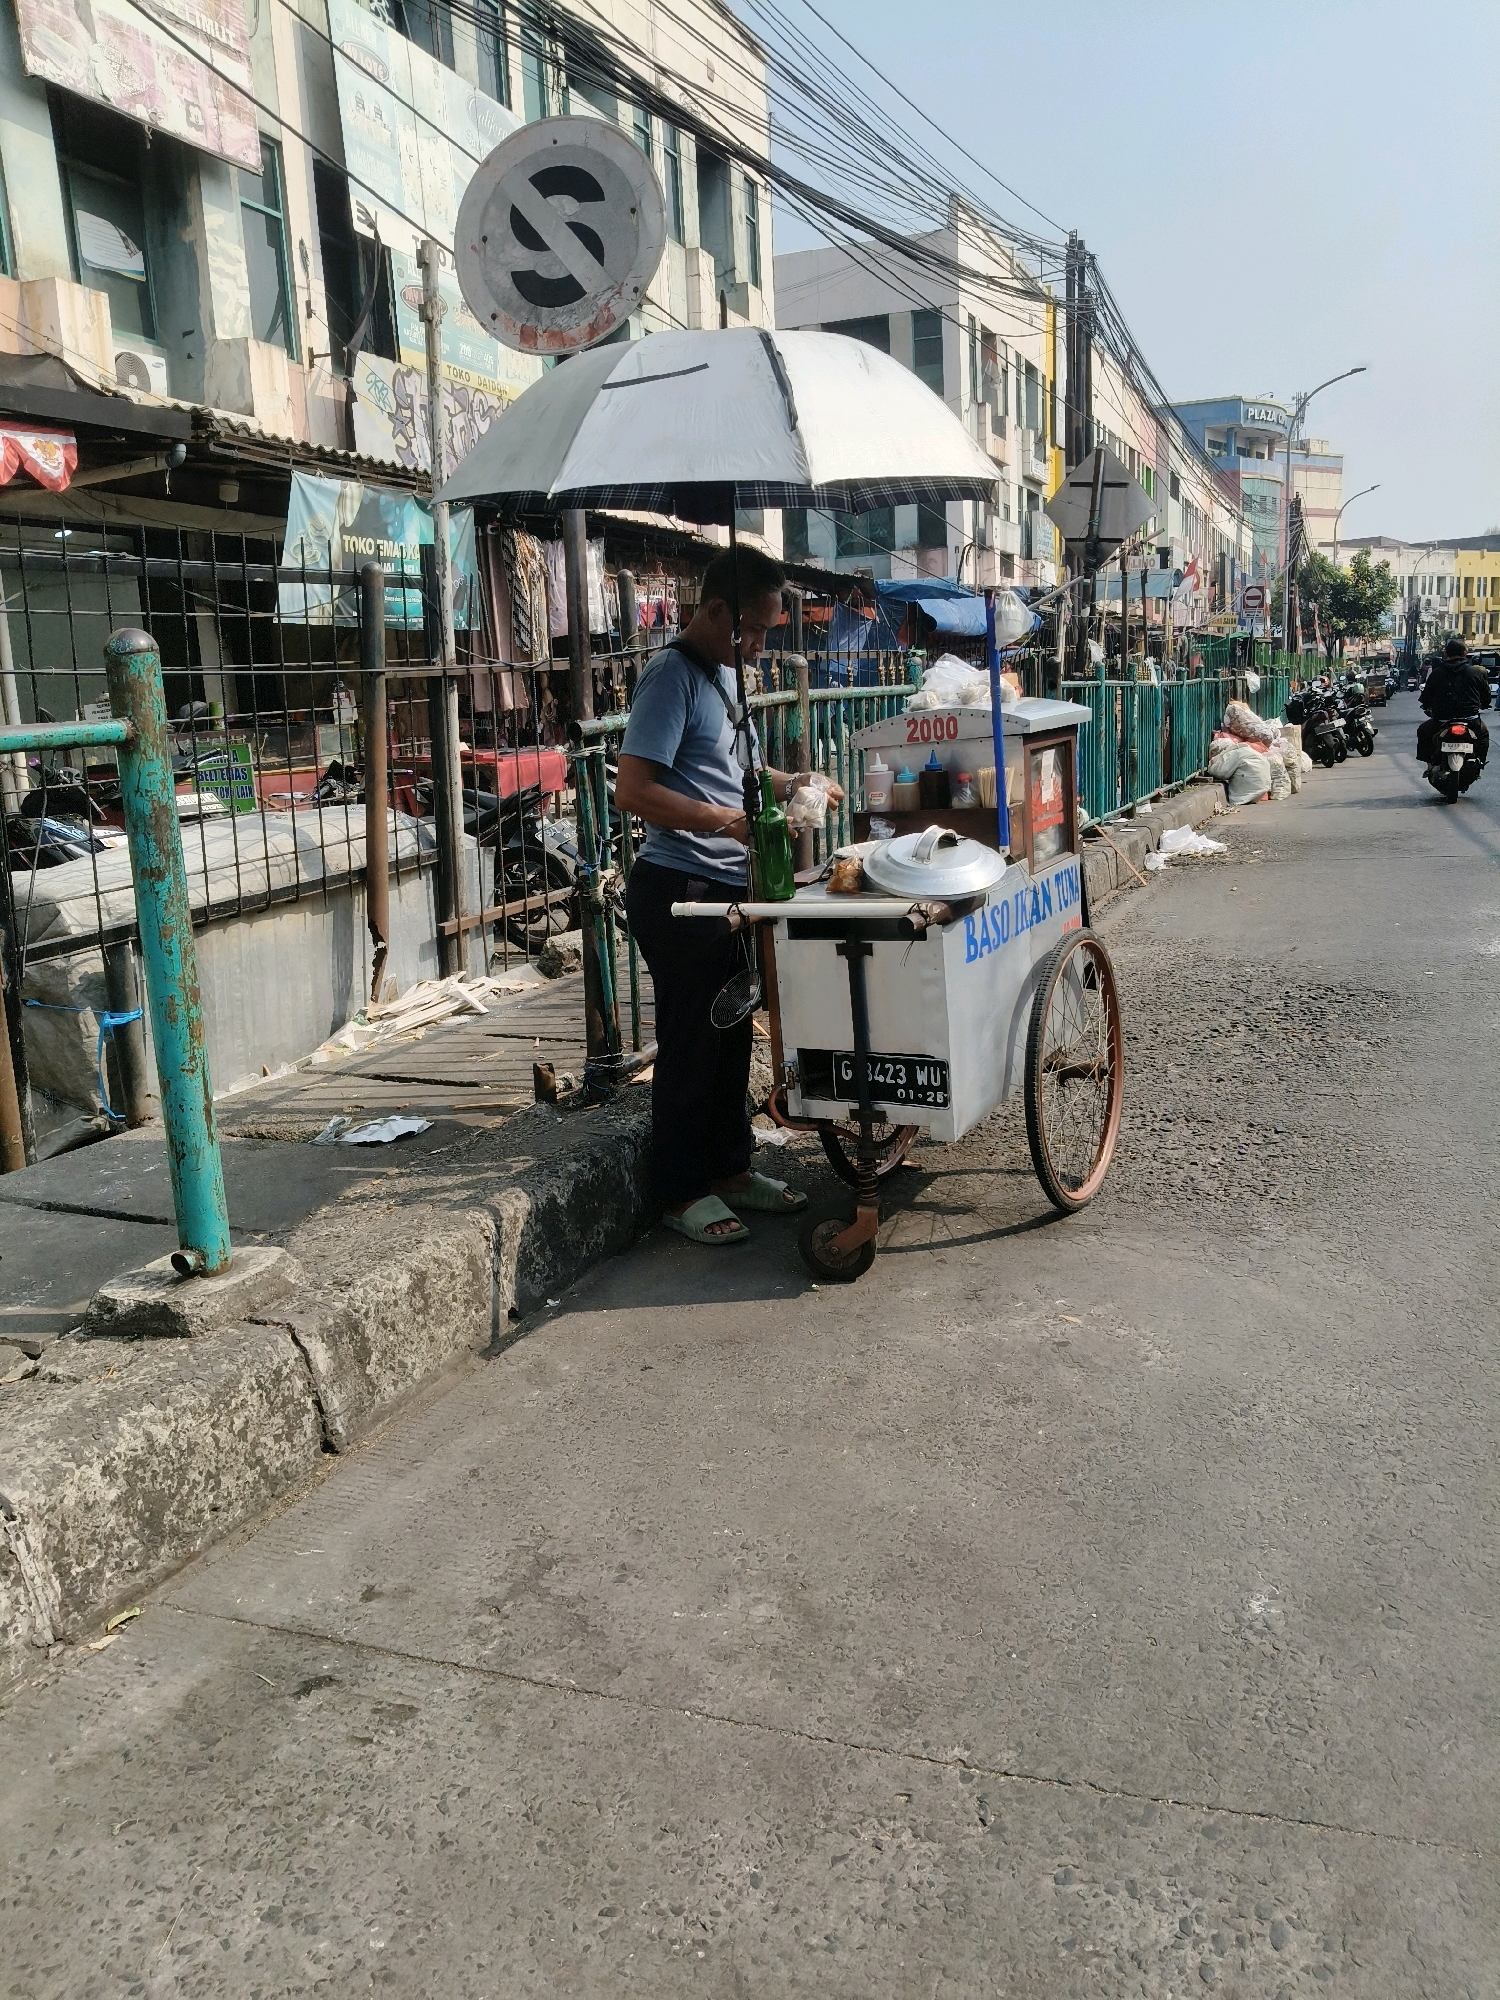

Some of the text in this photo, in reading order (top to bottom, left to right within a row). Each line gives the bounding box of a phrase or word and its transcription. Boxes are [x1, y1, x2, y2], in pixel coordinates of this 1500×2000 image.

[446, 364, 471, 383] TOKO
[1248, 407, 1277, 423] PLAZA
[343, 534, 375, 556] TOKO
[376, 538, 407, 559] EMAS
[906, 715, 958, 742] 2000
[1054, 864, 1081, 913] TUNA
[841, 1060, 853, 1081] G
[915, 1065, 941, 1087] WU
